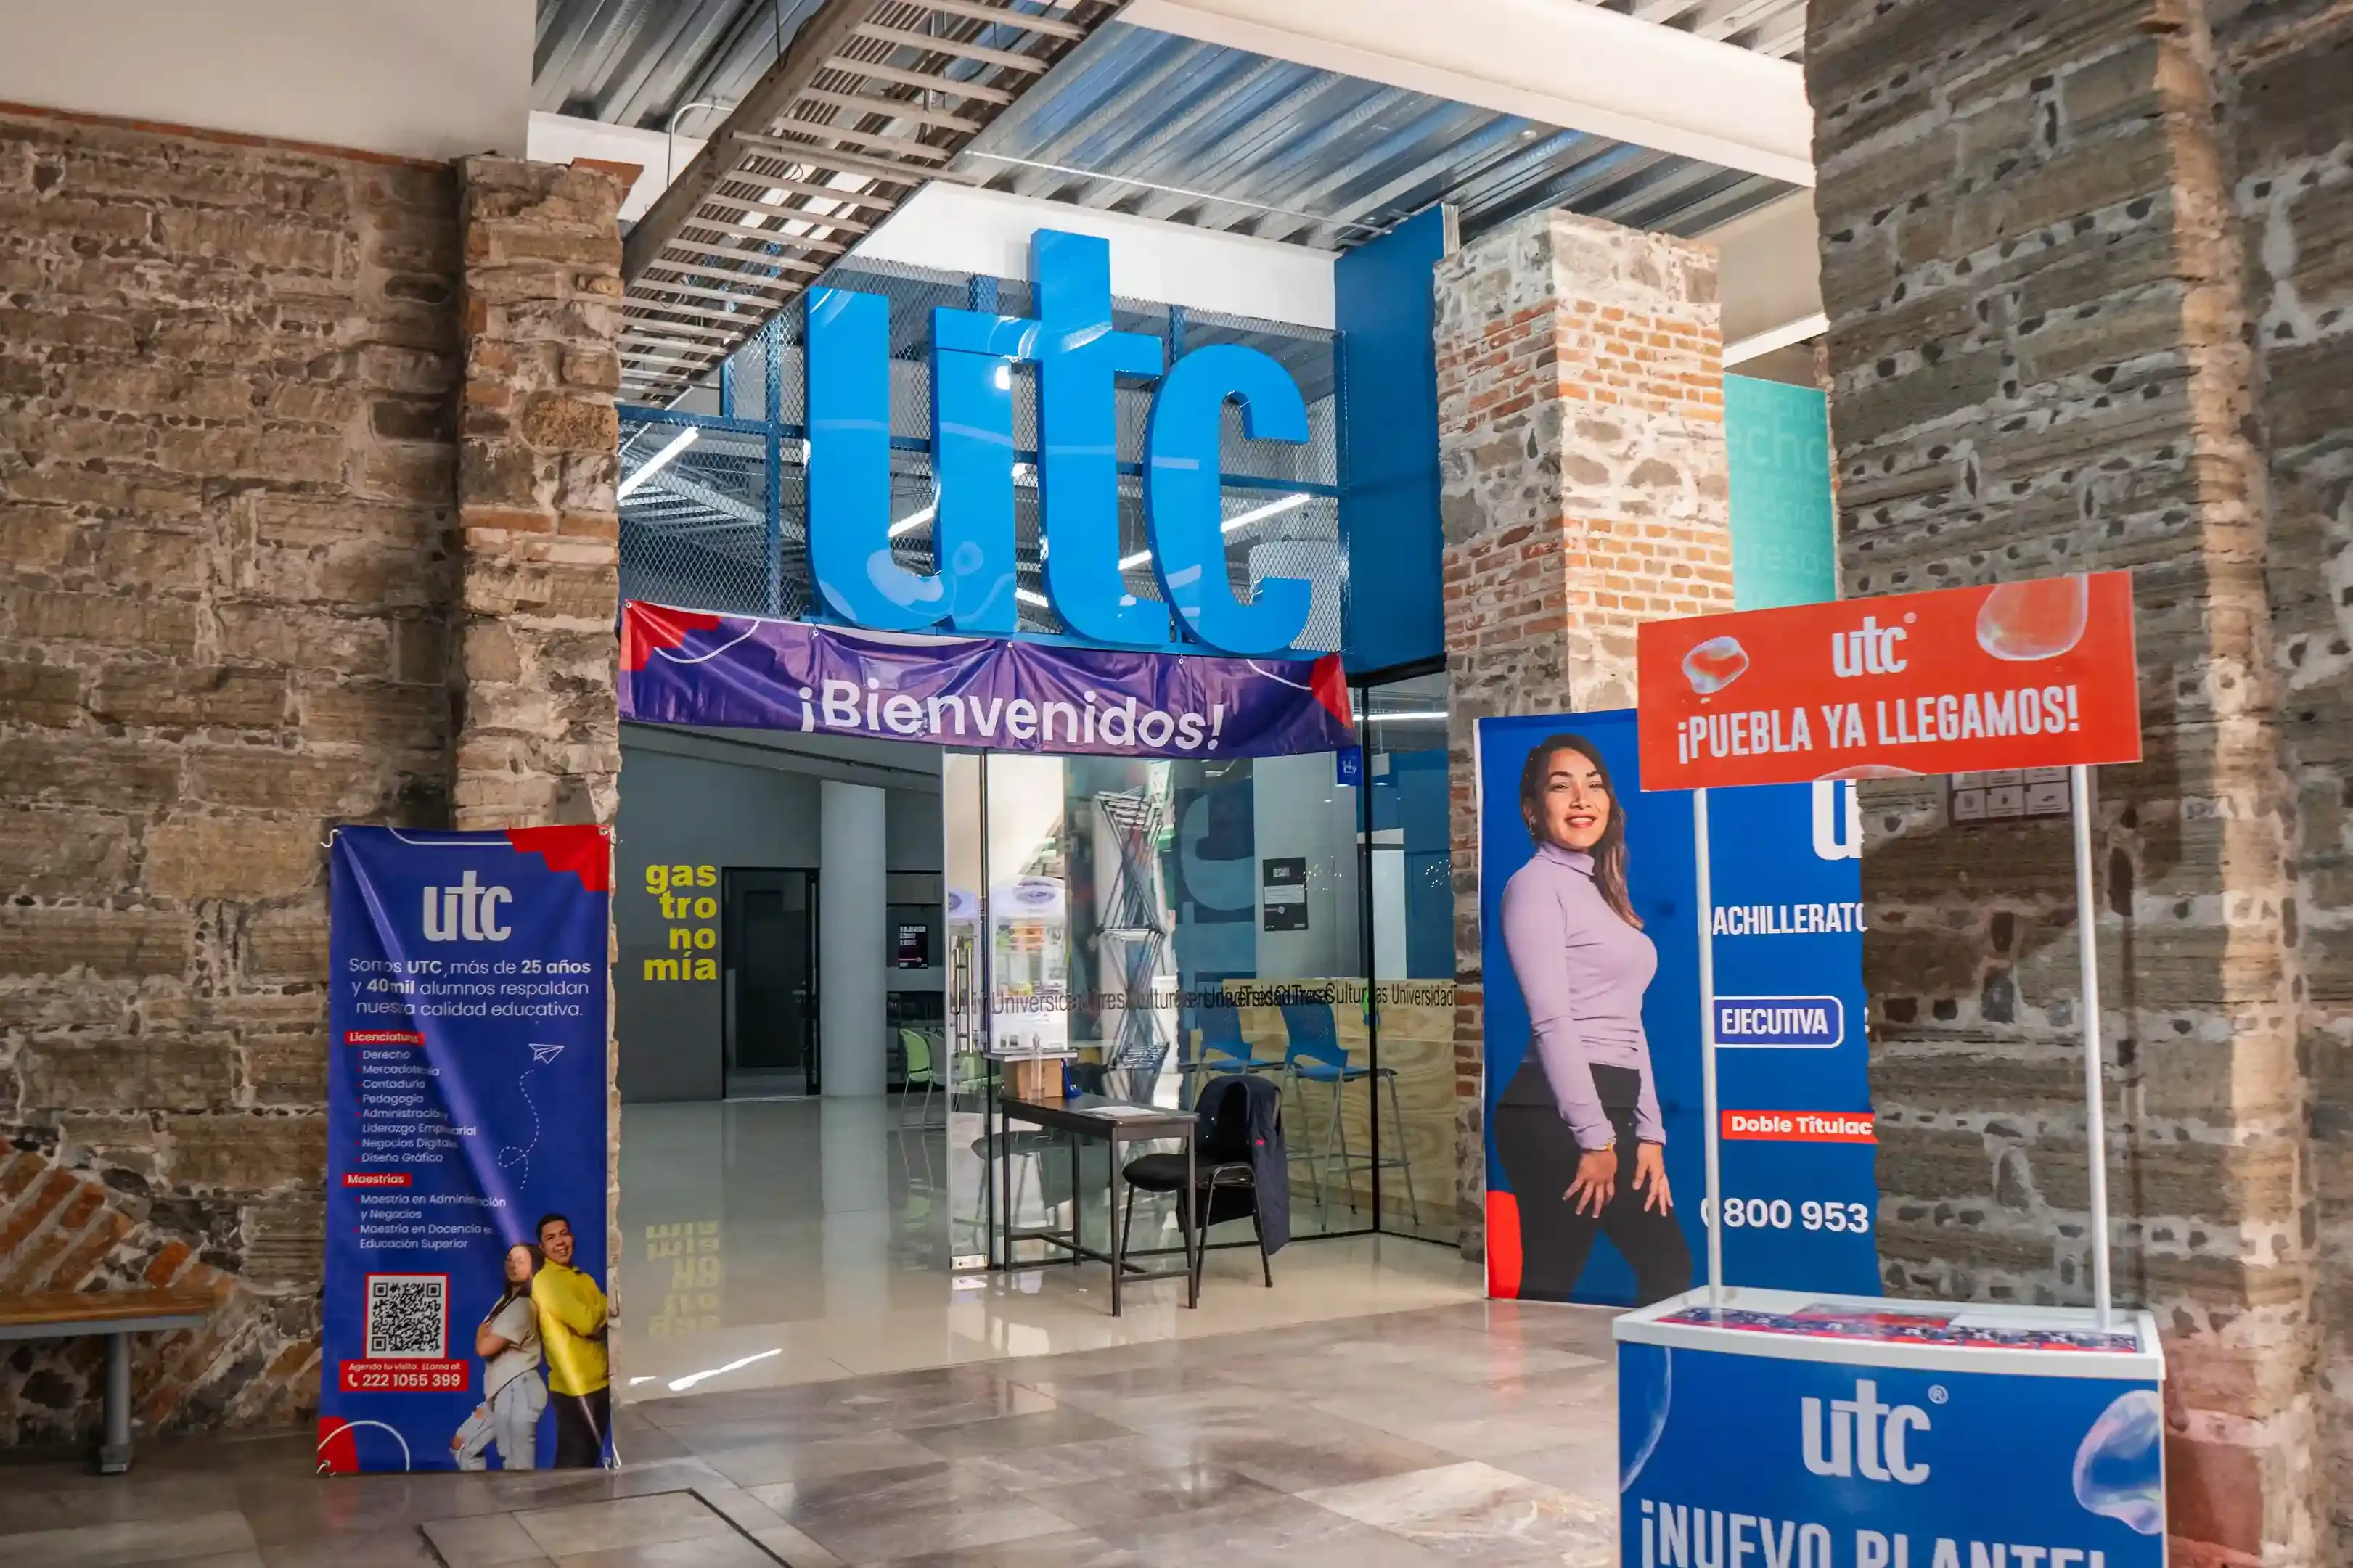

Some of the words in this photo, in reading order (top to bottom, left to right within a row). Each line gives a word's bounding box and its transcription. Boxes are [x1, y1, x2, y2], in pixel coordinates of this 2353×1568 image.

[803, 228, 1312, 654] utc
[1832, 615, 1908, 678] utc
[798, 678, 1224, 751] ¡Bienvenidos!
[1677, 707, 1812, 765] ¡PUEBLA
[1820, 702, 1866, 749] YA
[1875, 684, 2080, 746] LLEGAMOS!
[645, 864, 717, 894] gas
[422, 871, 512, 942] utc
[659, 890, 717, 919] tro
[1712, 902, 1868, 935] ACHILLERAT
[669, 927, 716, 950] no
[407, 960, 447, 978] UTC,
[450, 960, 488, 974] más
[494, 960, 517, 974] de
[520, 959, 541, 974] 25
[546, 959, 592, 974] años
[644, 951, 717, 980] mía
[351, 981, 362, 997] y
[420, 980, 495, 995] alumnos
[500, 980, 589, 999] respaldan
[1391, 983, 1454, 1006] Universidad
[356, 1001, 415, 1014] nuesa
[420, 1001, 486, 1016] calidad
[491, 1001, 583, 1016] educativa.
[1721, 1008, 1829, 1035] EJECUTIVA
[349, 1032, 419, 1043] Licenciatus
[363, 1050, 411, 1059] Derecho
[363, 1064, 440, 1076] Mercadoteia
[363, 1109, 441, 1118] Administració
[363, 1124, 415, 1136] Liderazgo
[418, 1123, 476, 1136] Emparial
[1732, 1115, 1793, 1133] Doble
[1796, 1116, 1874, 1136] Titulac
[362, 1138, 414, 1150] Negocios
[417, 1138, 458, 1150] Digita
[361, 1153, 398, 1162] Diseño
[402, 1152, 443, 1162] Gráfico
[348, 1174, 404, 1184] Maestrías
[361, 1194, 409, 1204] Maestría
[430, 1194, 506, 1208] Adminición
[361, 1211, 366, 1220] y
[370, 1210, 422, 1222] Negocios
[1801, 1202, 1870, 1234] 953
[360, 1224, 409, 1234] Maestría
[428, 1223, 481, 1234] Docencia
[360, 1239, 418, 1248] Educación
[421, 1239, 468, 1251] Superior
[348, 1363, 382, 1373] Agenda
[362, 1374, 389, 1387] 222
[393, 1374, 428, 1387] 1055
[432, 1374, 460, 1387] 399
[1801, 1379, 1931, 1485] utc
